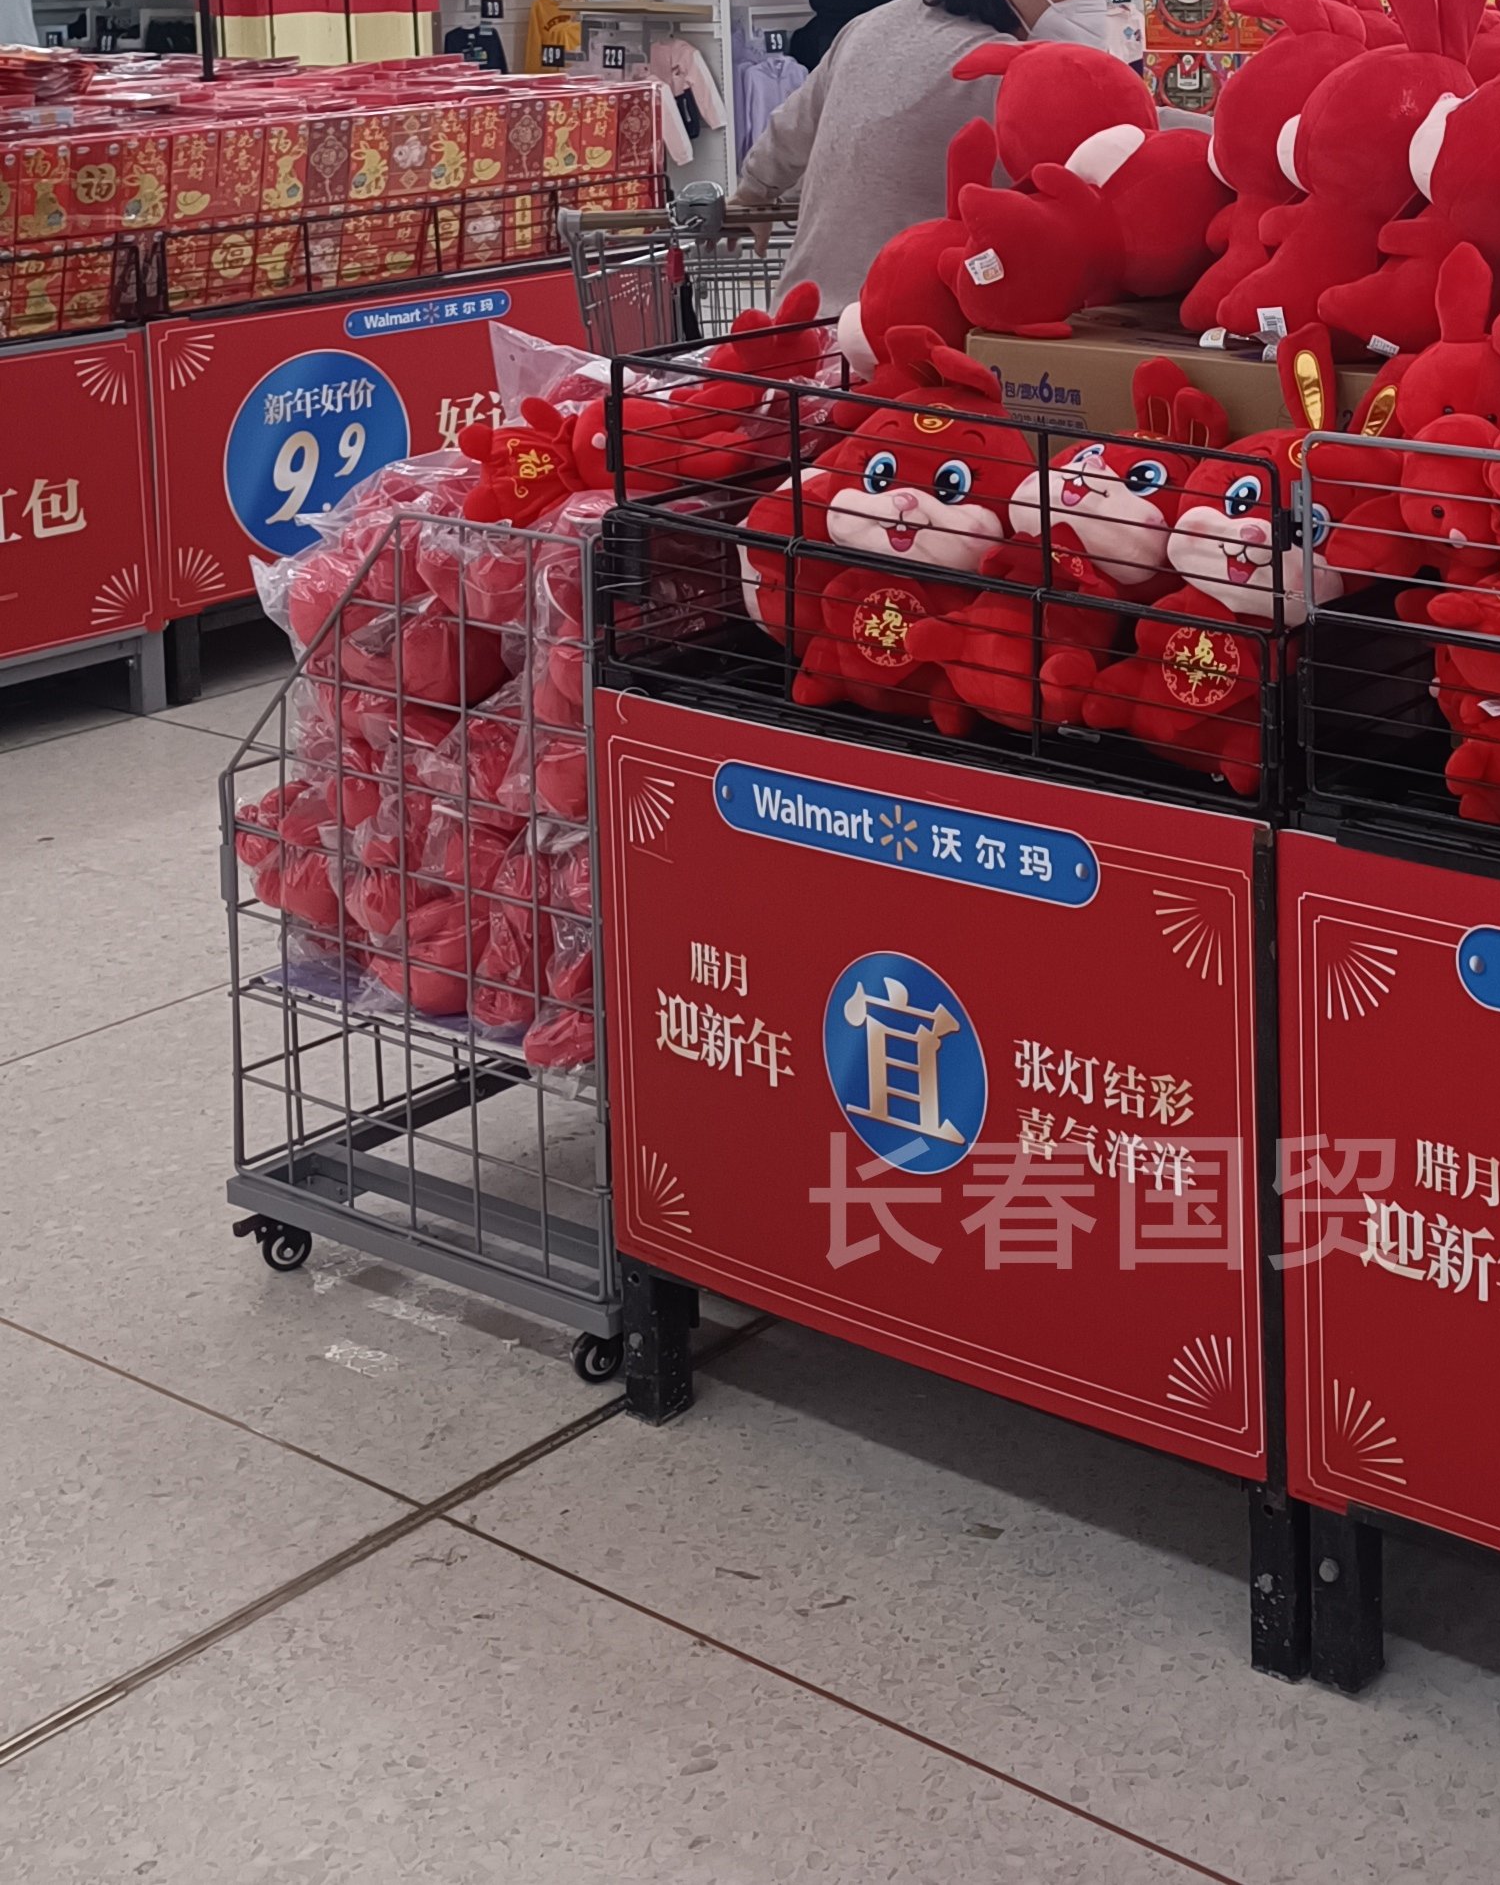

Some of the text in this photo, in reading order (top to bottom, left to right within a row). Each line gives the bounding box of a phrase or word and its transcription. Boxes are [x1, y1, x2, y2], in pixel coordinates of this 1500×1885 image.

[364, 298, 494, 330] Walmart 沃尔玛
[263, 376, 376, 426] 新年好价
[752, 782, 1053, 882] Walmart 沃尔玛
[688, 942, 748, 997] 腊月
[654, 988, 796, 1089] 迎新年
[843, 976, 967, 1146] 宜
[1012, 1038, 1196, 1127] 张灯结彩
[1015, 1106, 1198, 1197] 喜气洋洋
[1414, 1136, 1500, 1209] 腊月
